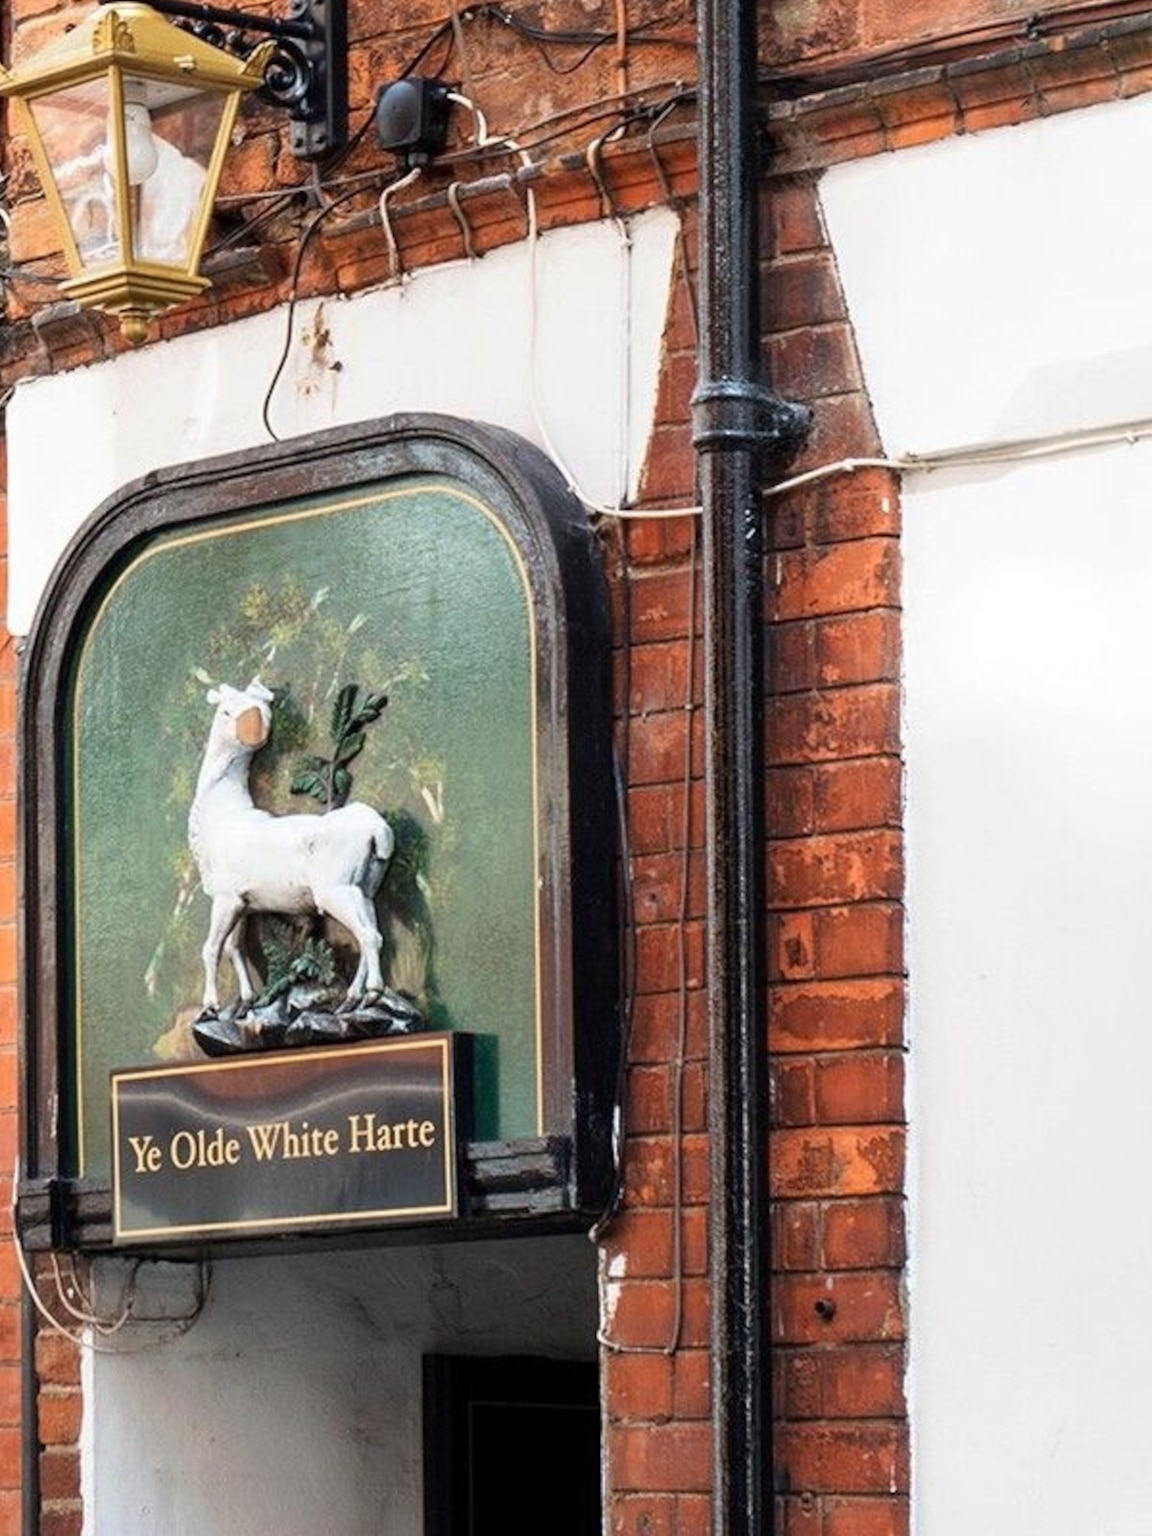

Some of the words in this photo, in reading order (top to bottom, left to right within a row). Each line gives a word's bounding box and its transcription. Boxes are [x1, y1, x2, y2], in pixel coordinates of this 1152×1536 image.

[128, 1135, 162, 1173] Ye
[170, 1127, 241, 1169] Olde
[247, 1122, 339, 1161] White
[348, 1113, 436, 1153] Harte
